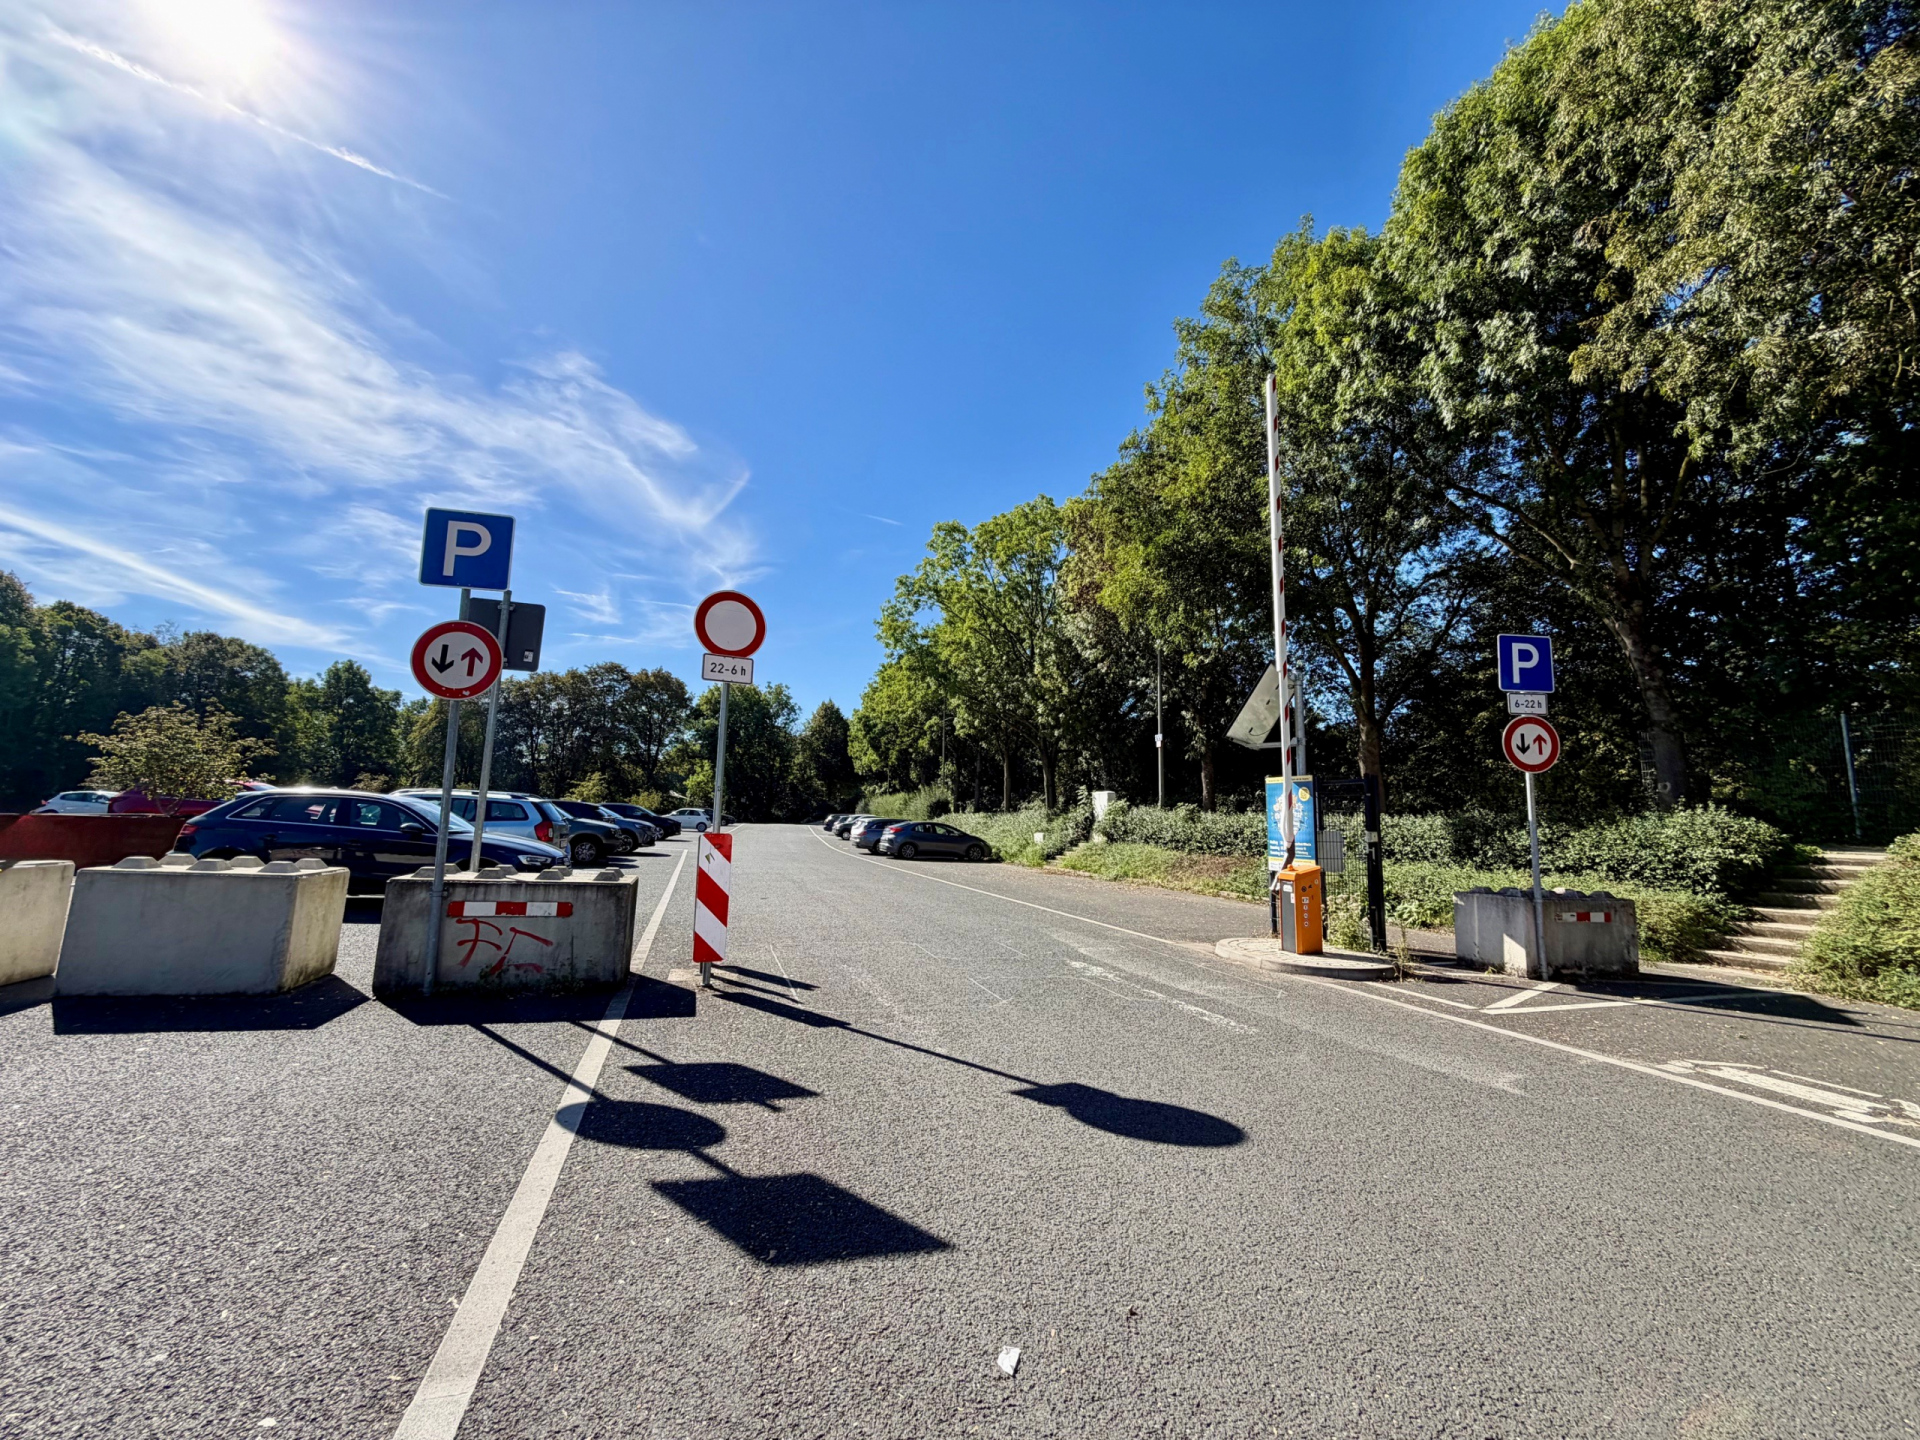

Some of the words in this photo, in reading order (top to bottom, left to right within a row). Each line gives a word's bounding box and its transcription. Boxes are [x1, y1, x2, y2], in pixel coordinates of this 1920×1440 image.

[442, 520, 492, 577] P
[710, 662, 737, 675] 22-6
[740, 666, 746, 676] h
[1511, 642, 1540, 684] P
[1514, 699, 1535, 708] 6-22
[1537, 700, 1542, 708] h
